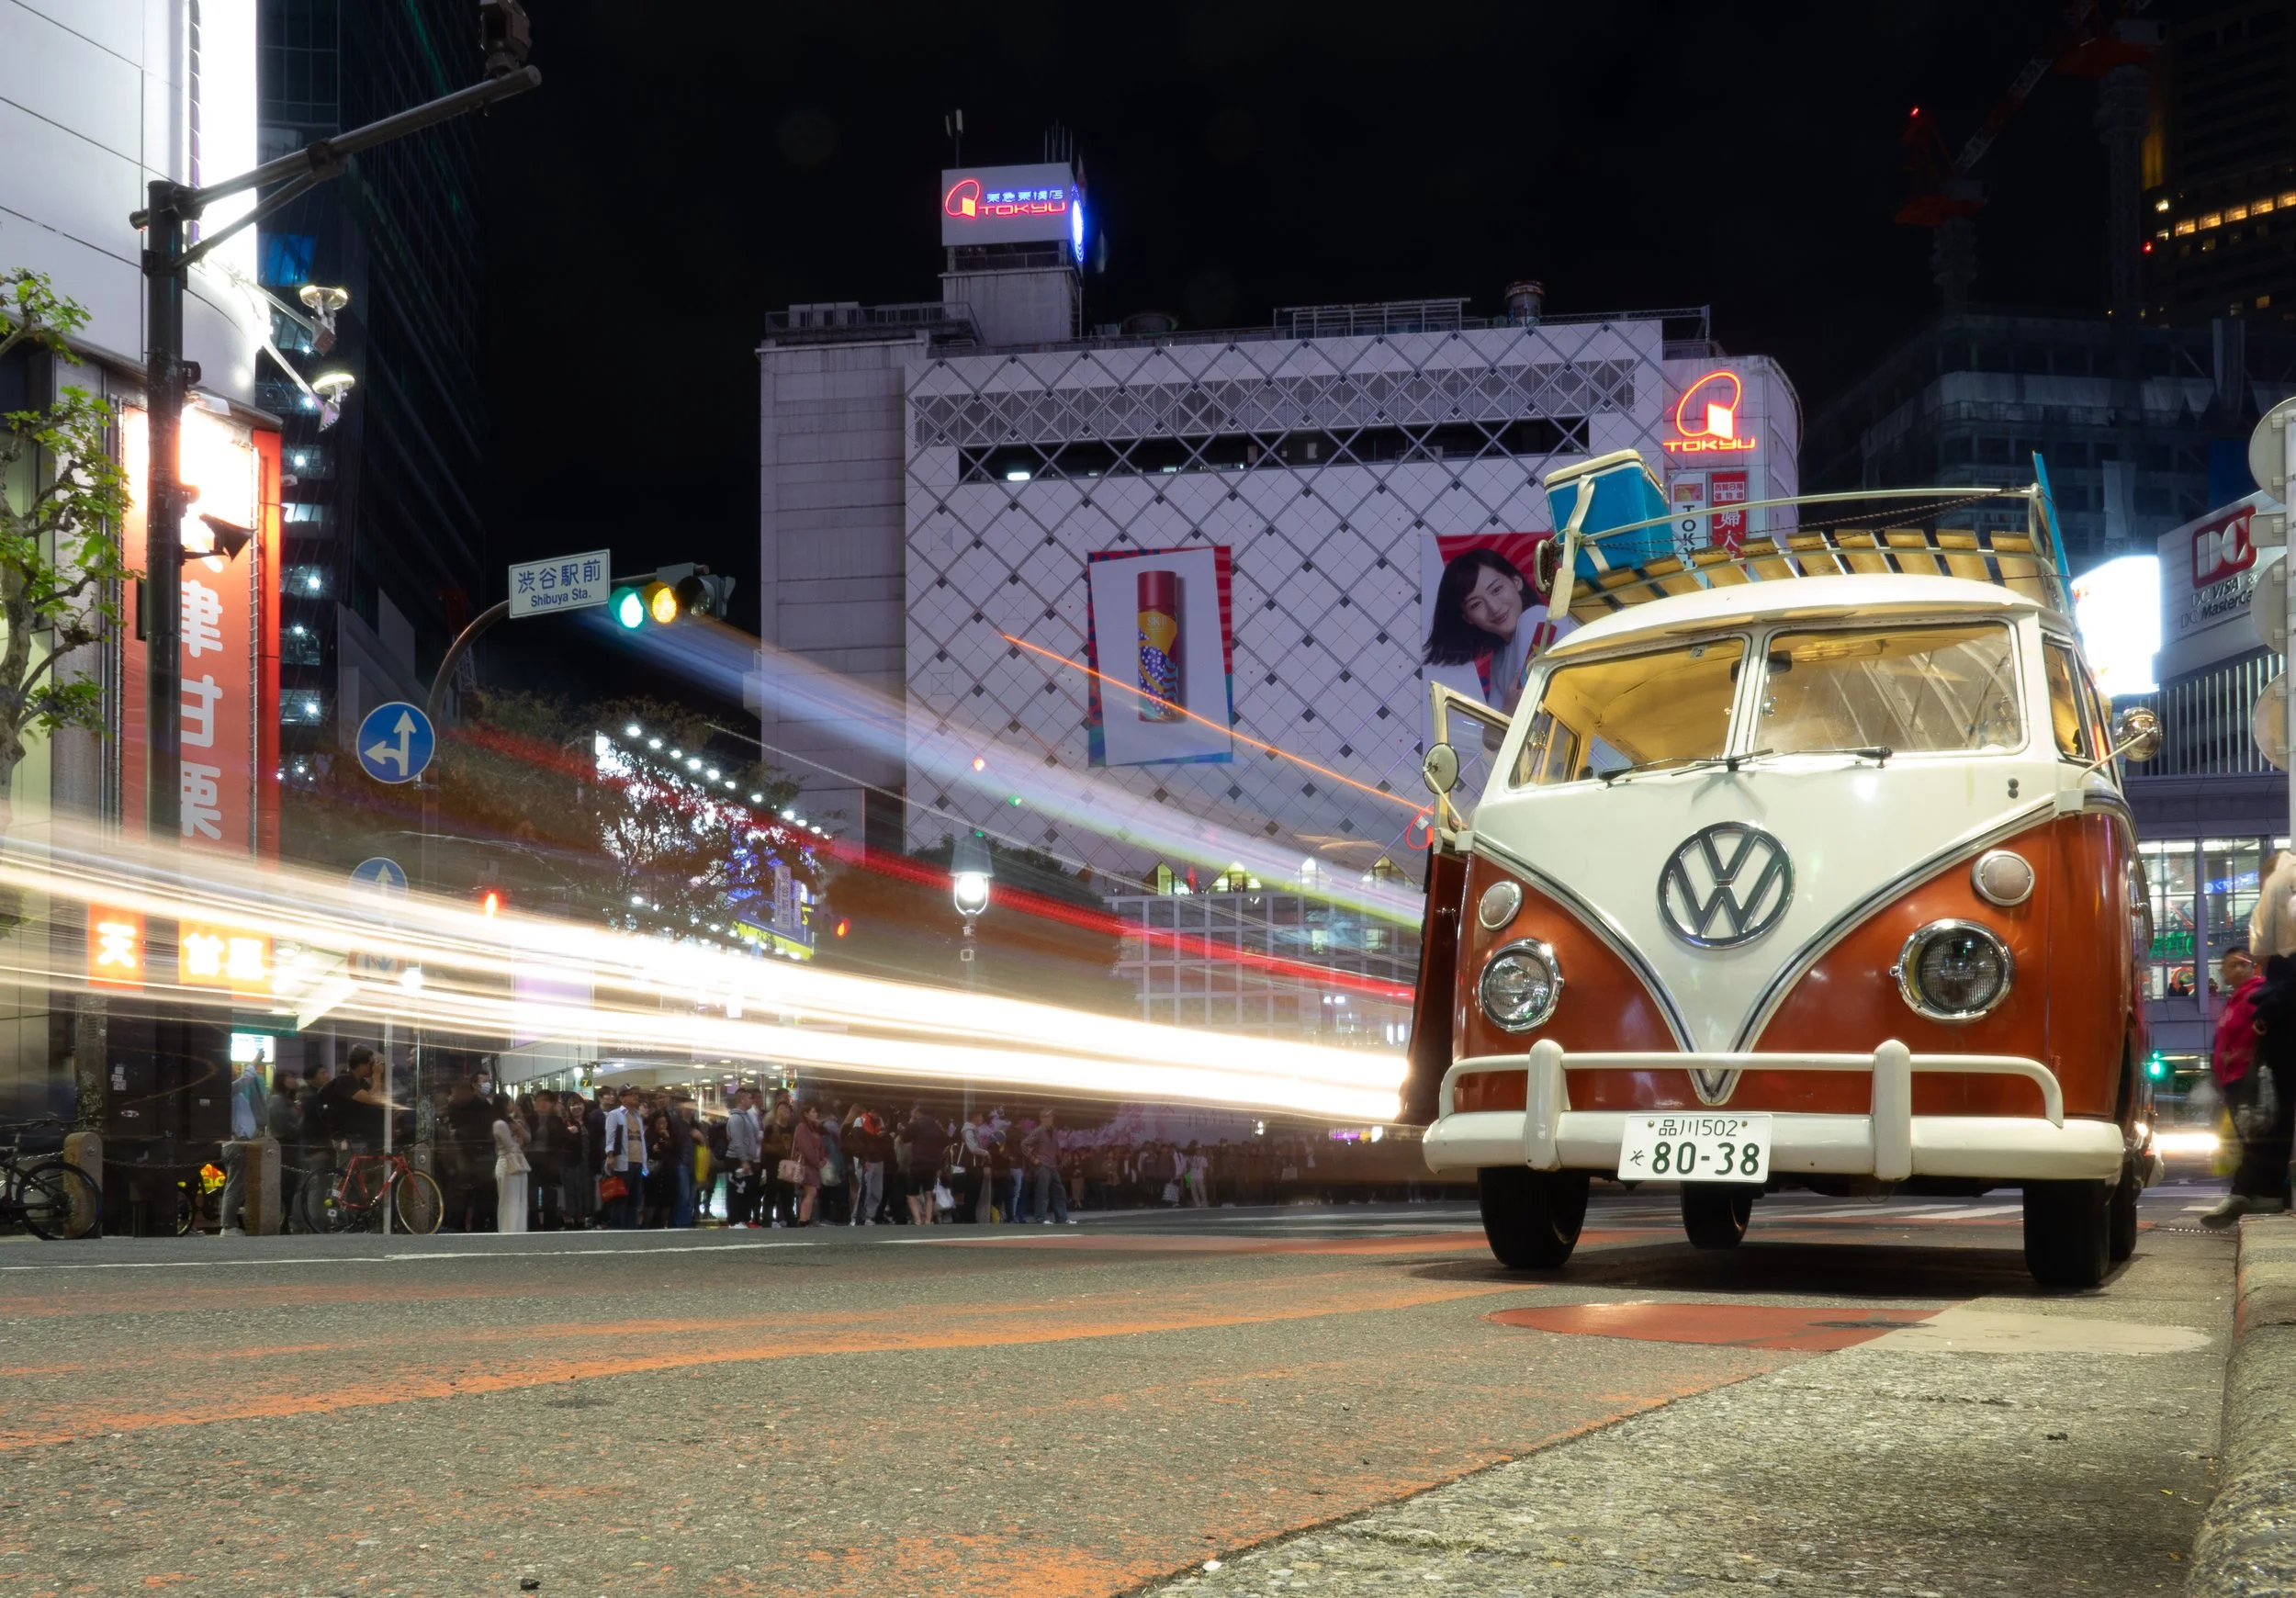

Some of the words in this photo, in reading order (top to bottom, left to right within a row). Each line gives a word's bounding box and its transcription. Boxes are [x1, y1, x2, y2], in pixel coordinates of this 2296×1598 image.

[979, 203, 1066, 216] TOKYU
[1663, 437, 1757, 453] TOKYU
[518, 558, 602, 594] 渋谷駅前
[531, 591, 568, 607] Shibuya
[571, 588, 591, 601] Sta.
[2213, 577, 2240, 599] VISA
[2201, 591, 2252, 620] MasterCa
[1652, 1142, 1760, 1176] 80-38
